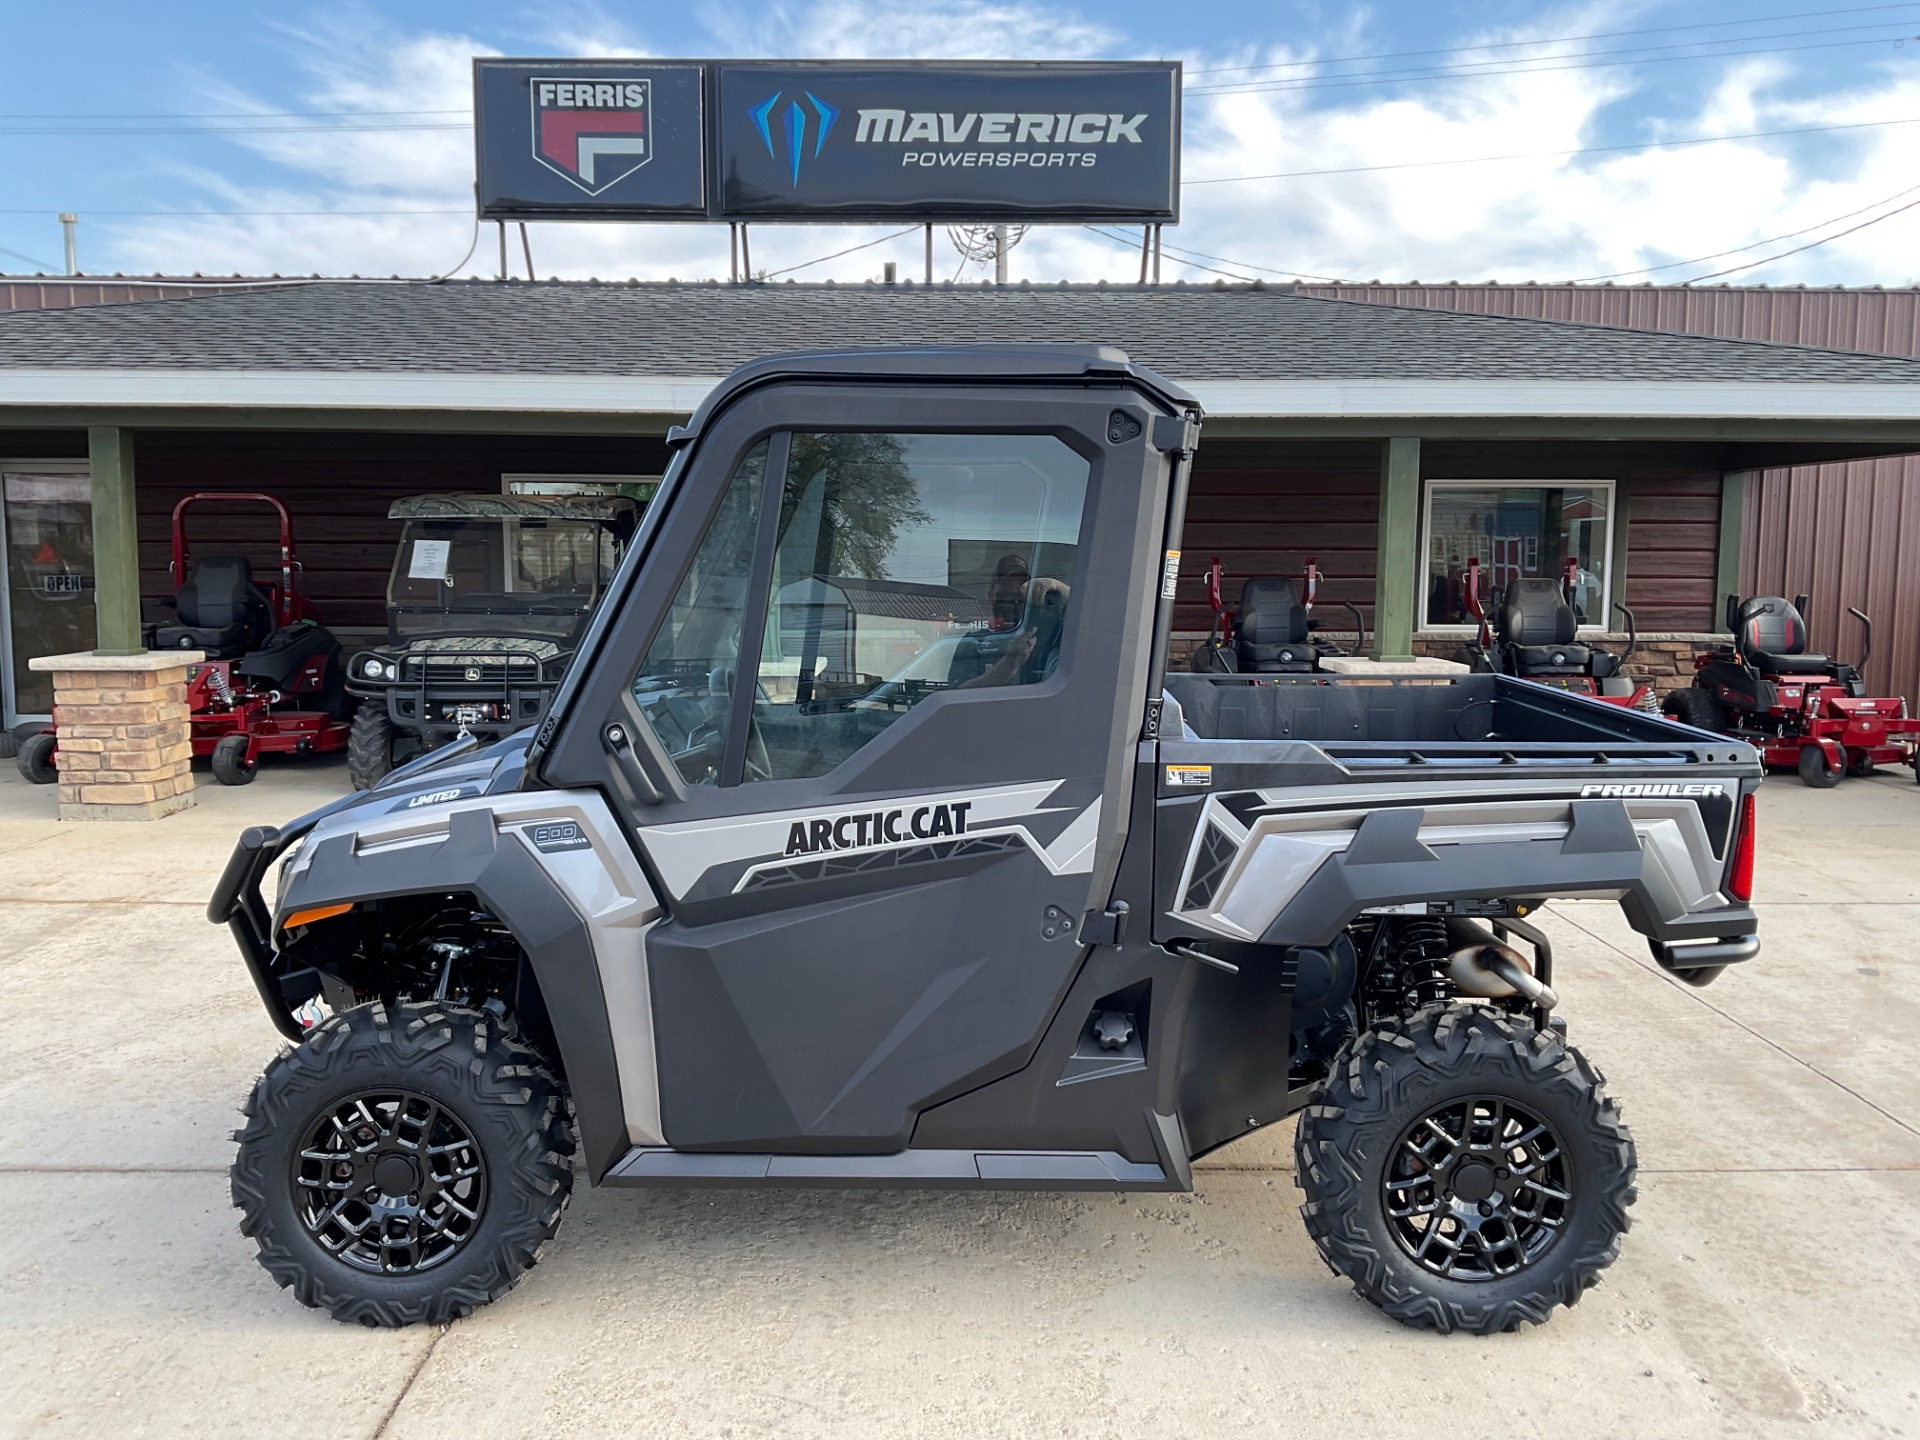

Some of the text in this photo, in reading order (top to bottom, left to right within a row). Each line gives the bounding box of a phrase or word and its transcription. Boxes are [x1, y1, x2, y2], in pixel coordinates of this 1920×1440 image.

[539, 83, 644, 108] FERRIS
[855, 108, 1149, 143] MAVERICK
[902, 151, 1097, 167] POWERSPORTS
[46, 576, 81, 592] OPEN
[408, 788, 461, 808] LIMITED
[1580, 783, 1724, 799] PROWLER
[783, 801, 972, 857] ARCTIC CAT
